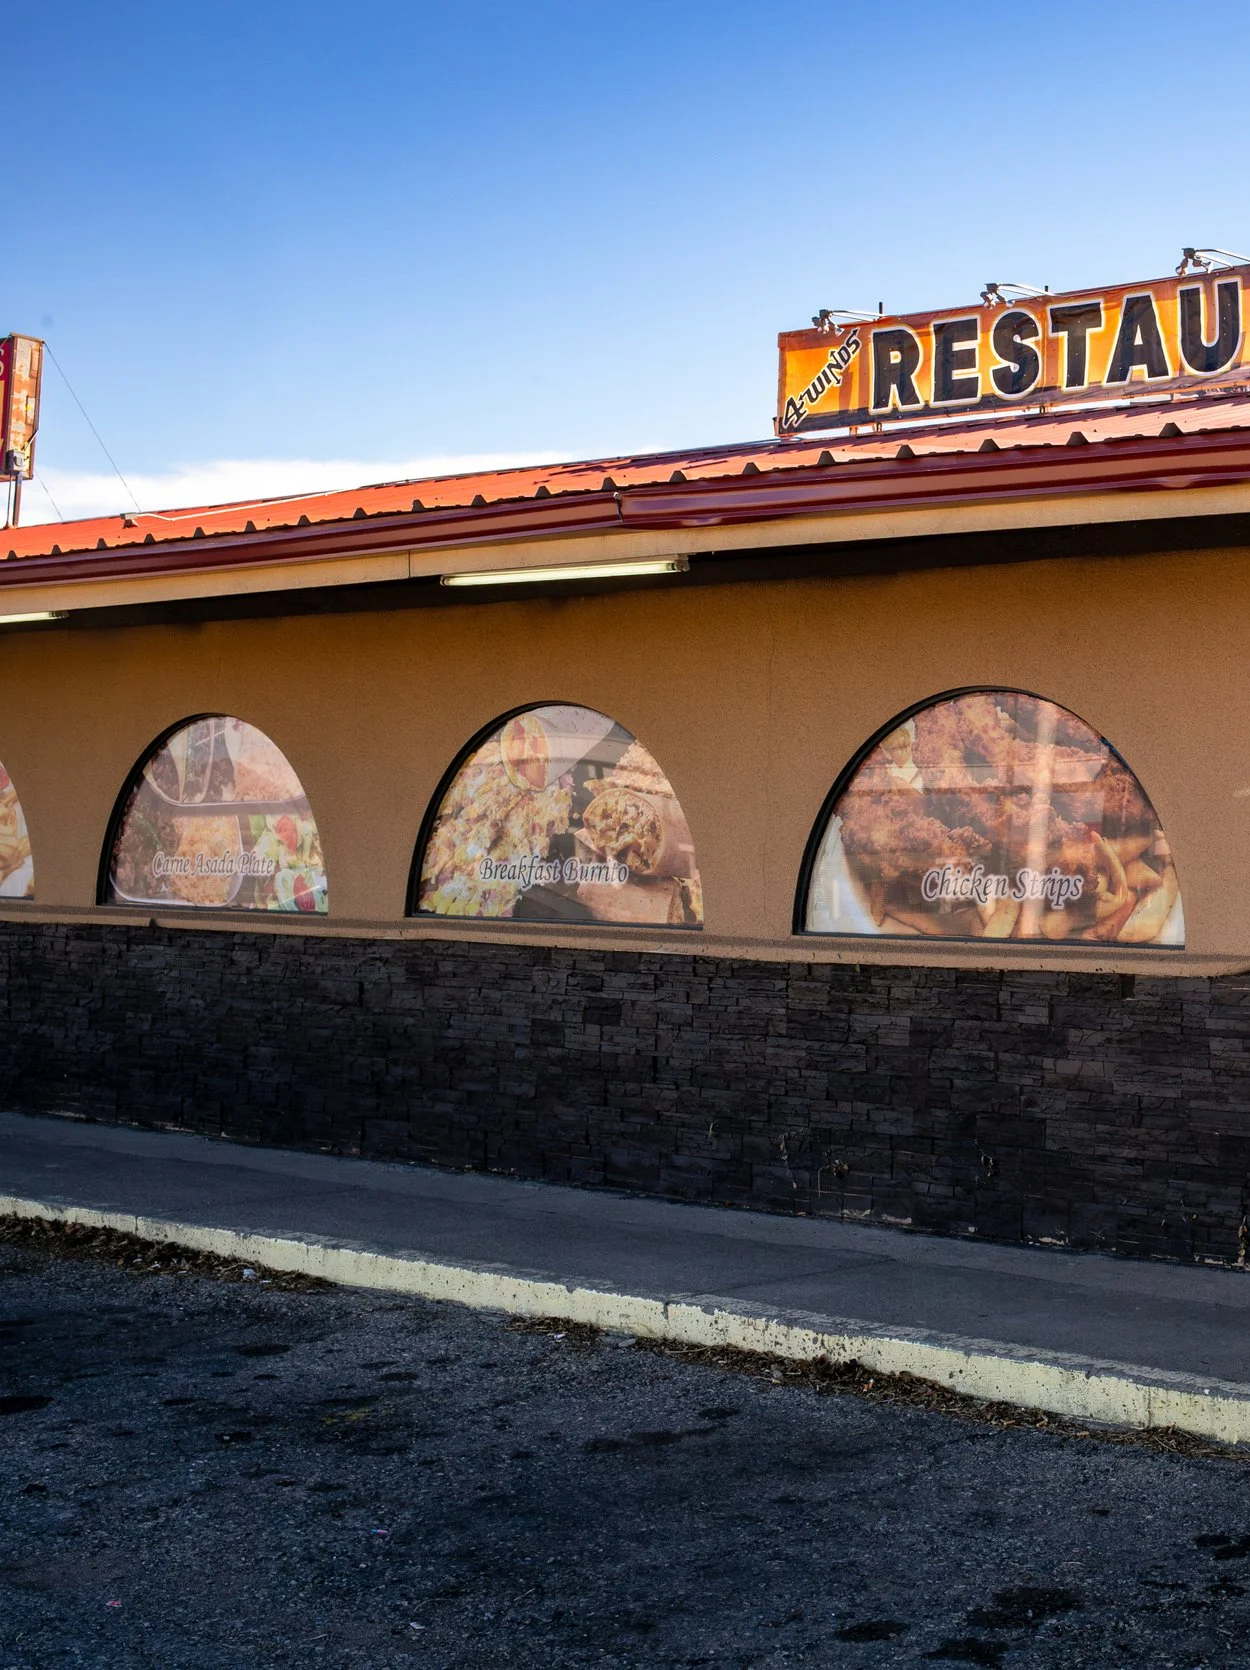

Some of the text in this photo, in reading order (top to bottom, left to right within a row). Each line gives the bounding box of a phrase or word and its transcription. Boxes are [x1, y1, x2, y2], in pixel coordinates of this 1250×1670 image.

[782, 328, 862, 428] 4 WINDS
[153, 851, 275, 876] Carne Asada Plate
[479, 855, 628, 887] Breakfast Burrito
[923, 866, 1083, 907] Chicken Strips
